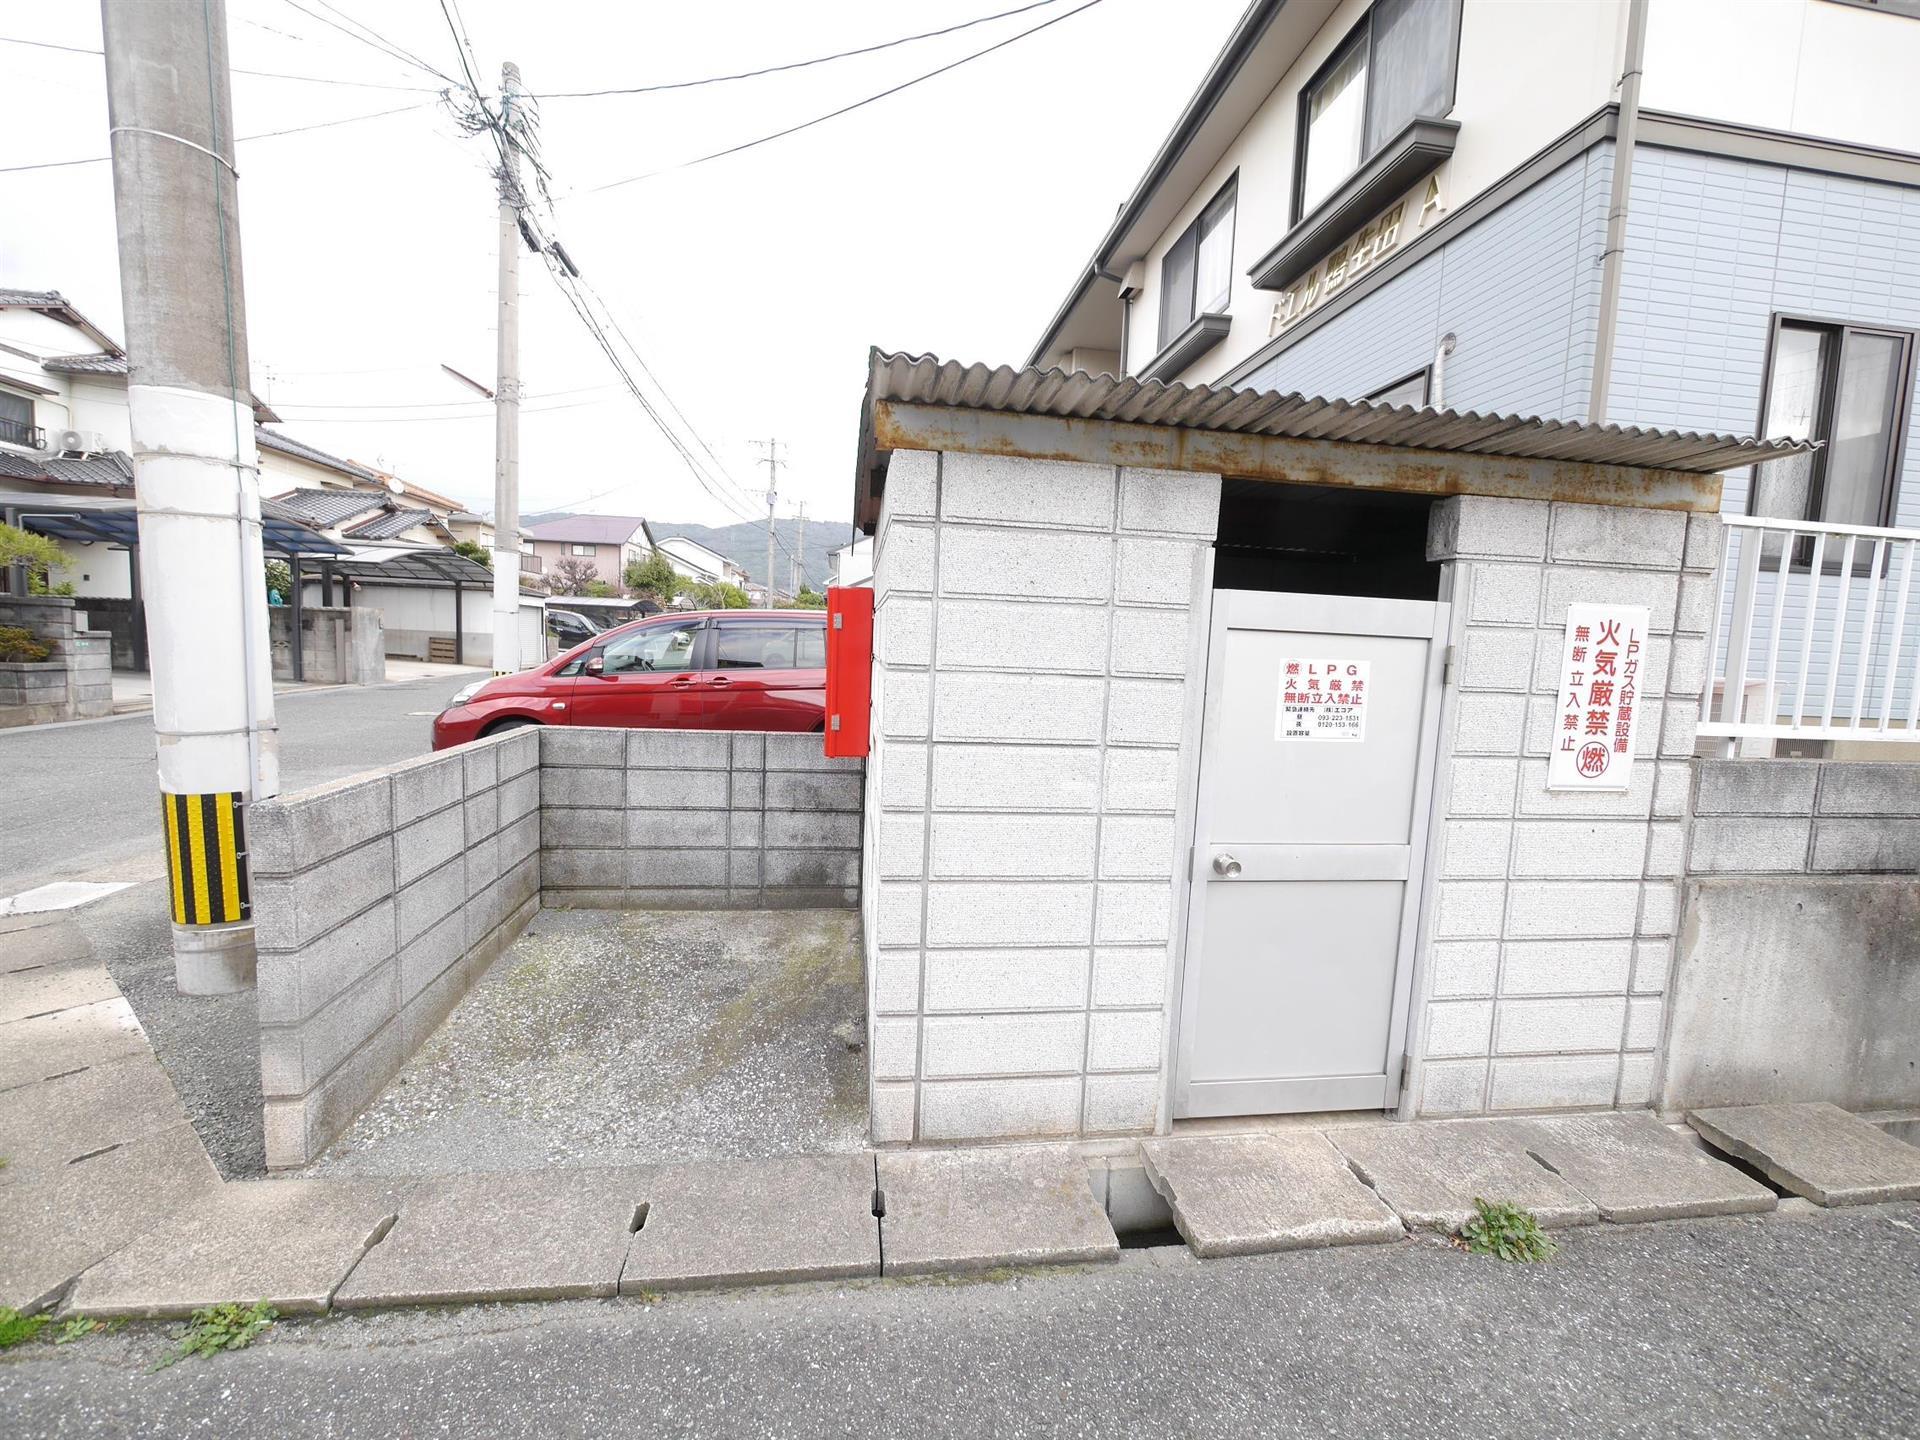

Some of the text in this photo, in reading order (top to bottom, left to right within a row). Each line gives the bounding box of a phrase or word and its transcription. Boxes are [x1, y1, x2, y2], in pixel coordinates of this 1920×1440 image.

[1417, 173, 1447, 228] A
[1283, 692, 1363, 705] 無断立入禁止
[1285, 678, 1364, 692] 火気厳禁
[1560, 624, 1591, 753] 無断立入禁止
[1584, 618, 1622, 737] 火気厳禁
[1613, 628, 1640, 754] LPガス貯蔵設備
[1579, 744, 1606, 774] 燃
